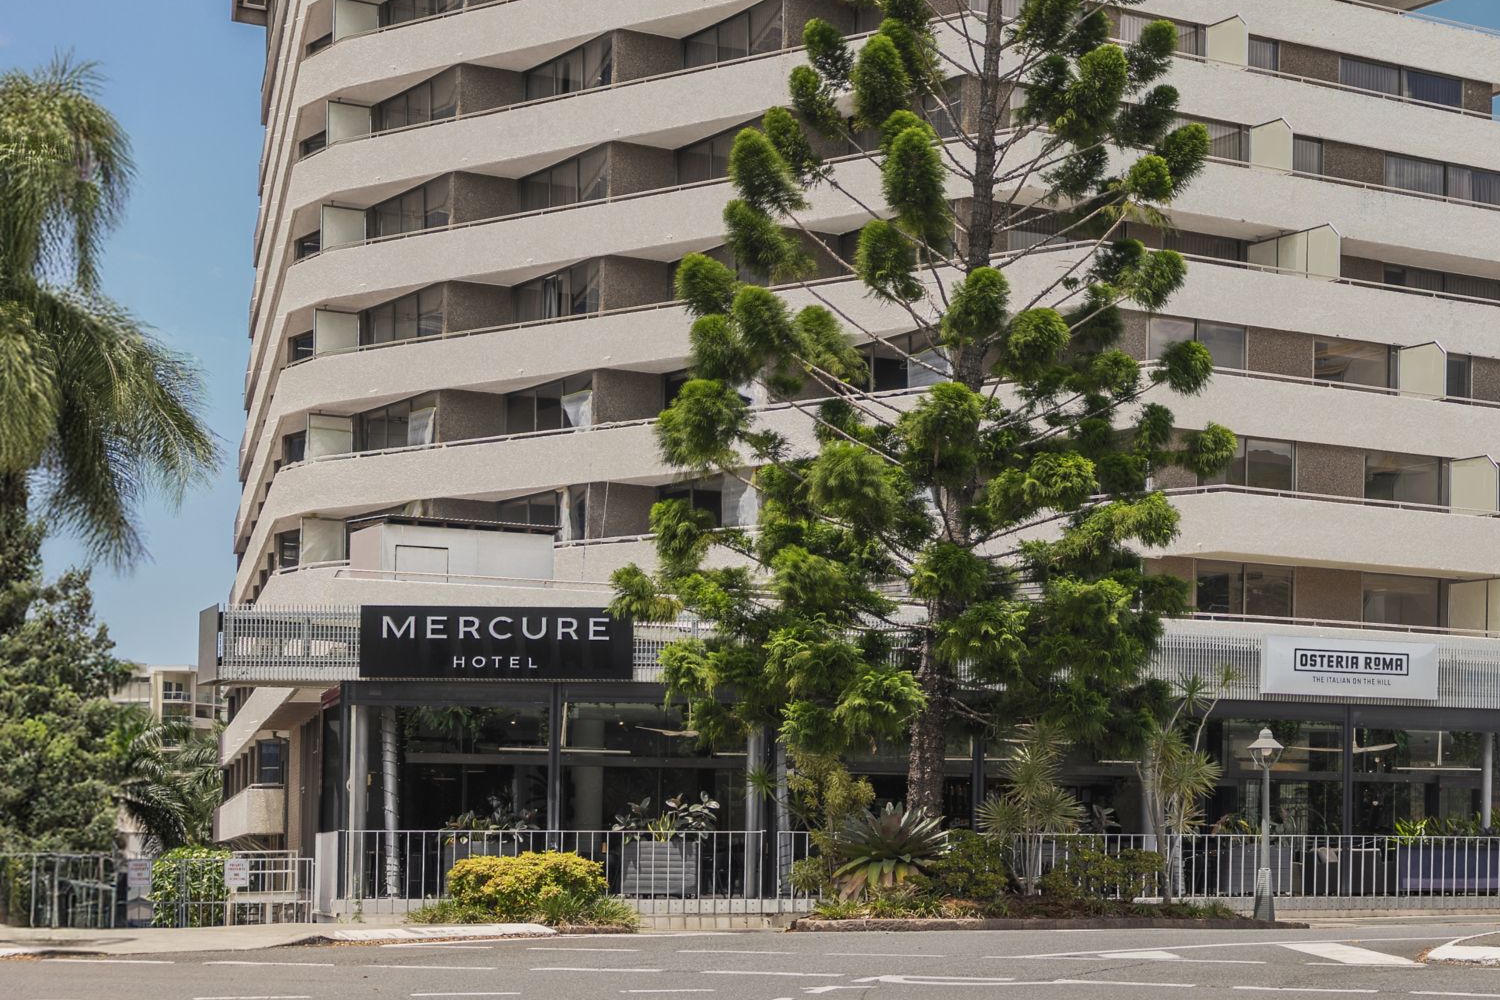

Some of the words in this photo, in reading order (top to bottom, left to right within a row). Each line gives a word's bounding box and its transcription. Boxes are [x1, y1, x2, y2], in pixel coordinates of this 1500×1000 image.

[381, 615, 611, 641] MERCURE
[453, 656, 538, 669] HOTEL
[1300, 653, 1359, 669] OSTERIA
[1364, 656, 1404, 671] ROMA
[1312, 675, 1325, 684] THE
[1326, 676, 1351, 685] ITALIAN
[1352, 677, 1362, 686] ON
[1363, 678, 1376, 686] THE
[1376, 679, 1392, 687] HILL
